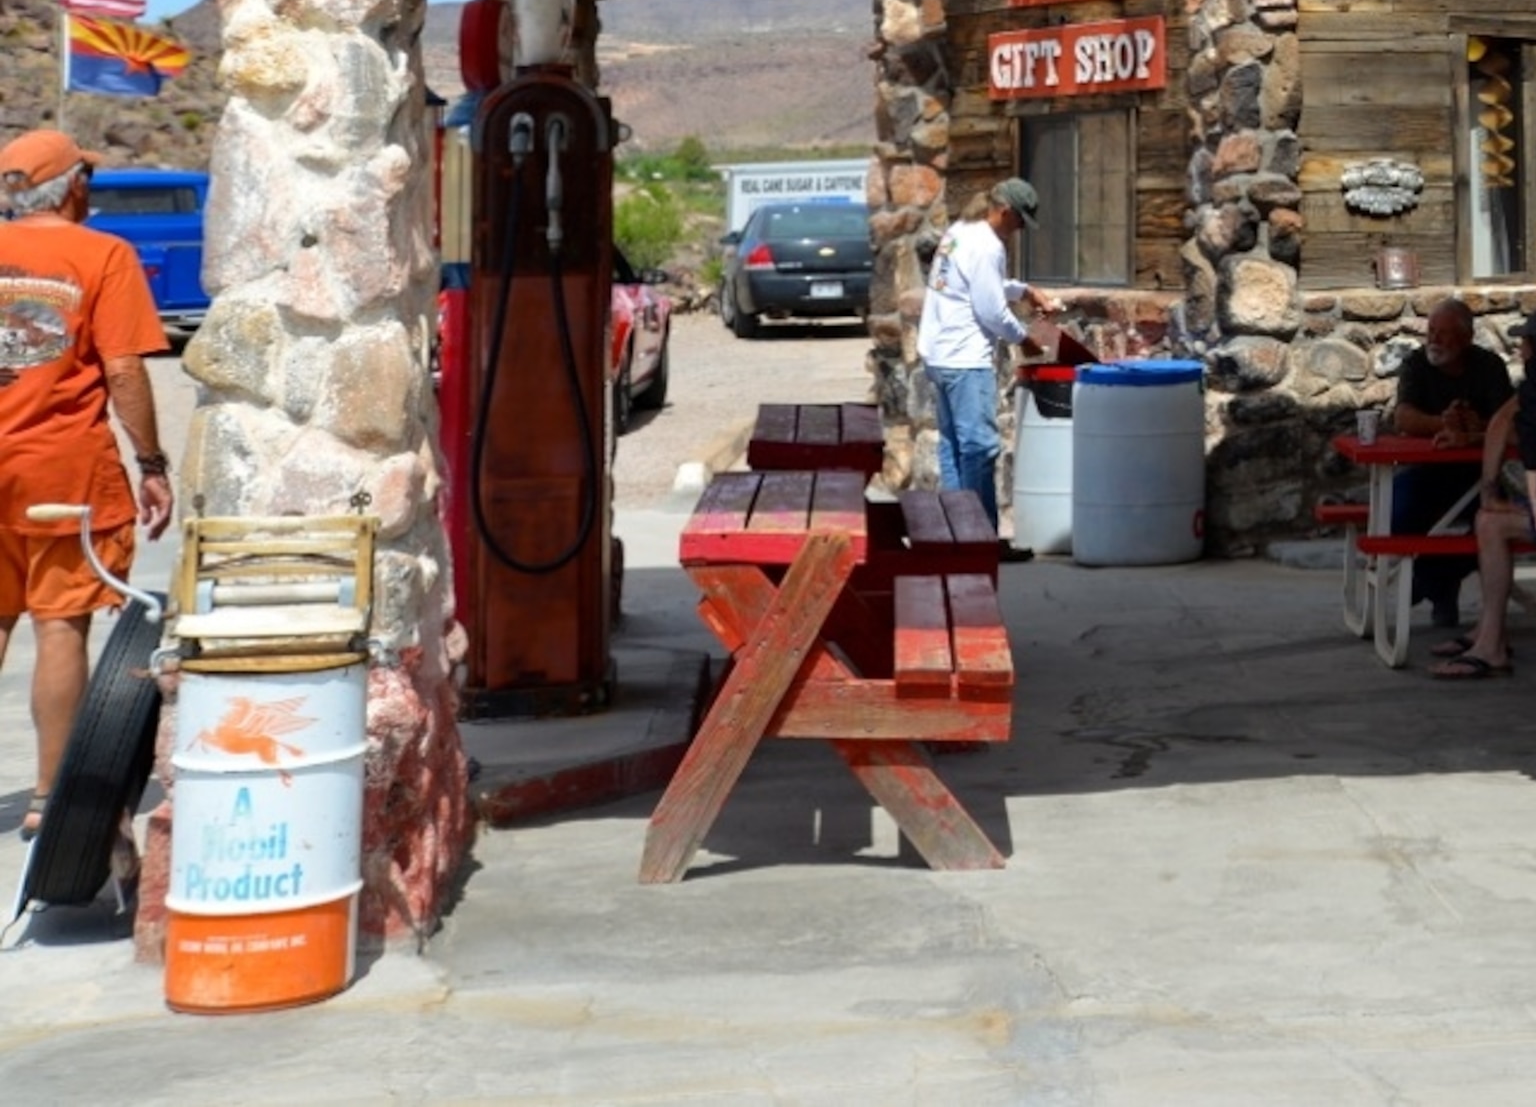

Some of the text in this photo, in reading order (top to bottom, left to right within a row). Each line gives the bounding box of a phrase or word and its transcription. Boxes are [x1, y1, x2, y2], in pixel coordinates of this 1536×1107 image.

[991, 29, 1155, 89] GIFT SHOP
[232, 787, 252, 820] A
[185, 863, 303, 902] Product
